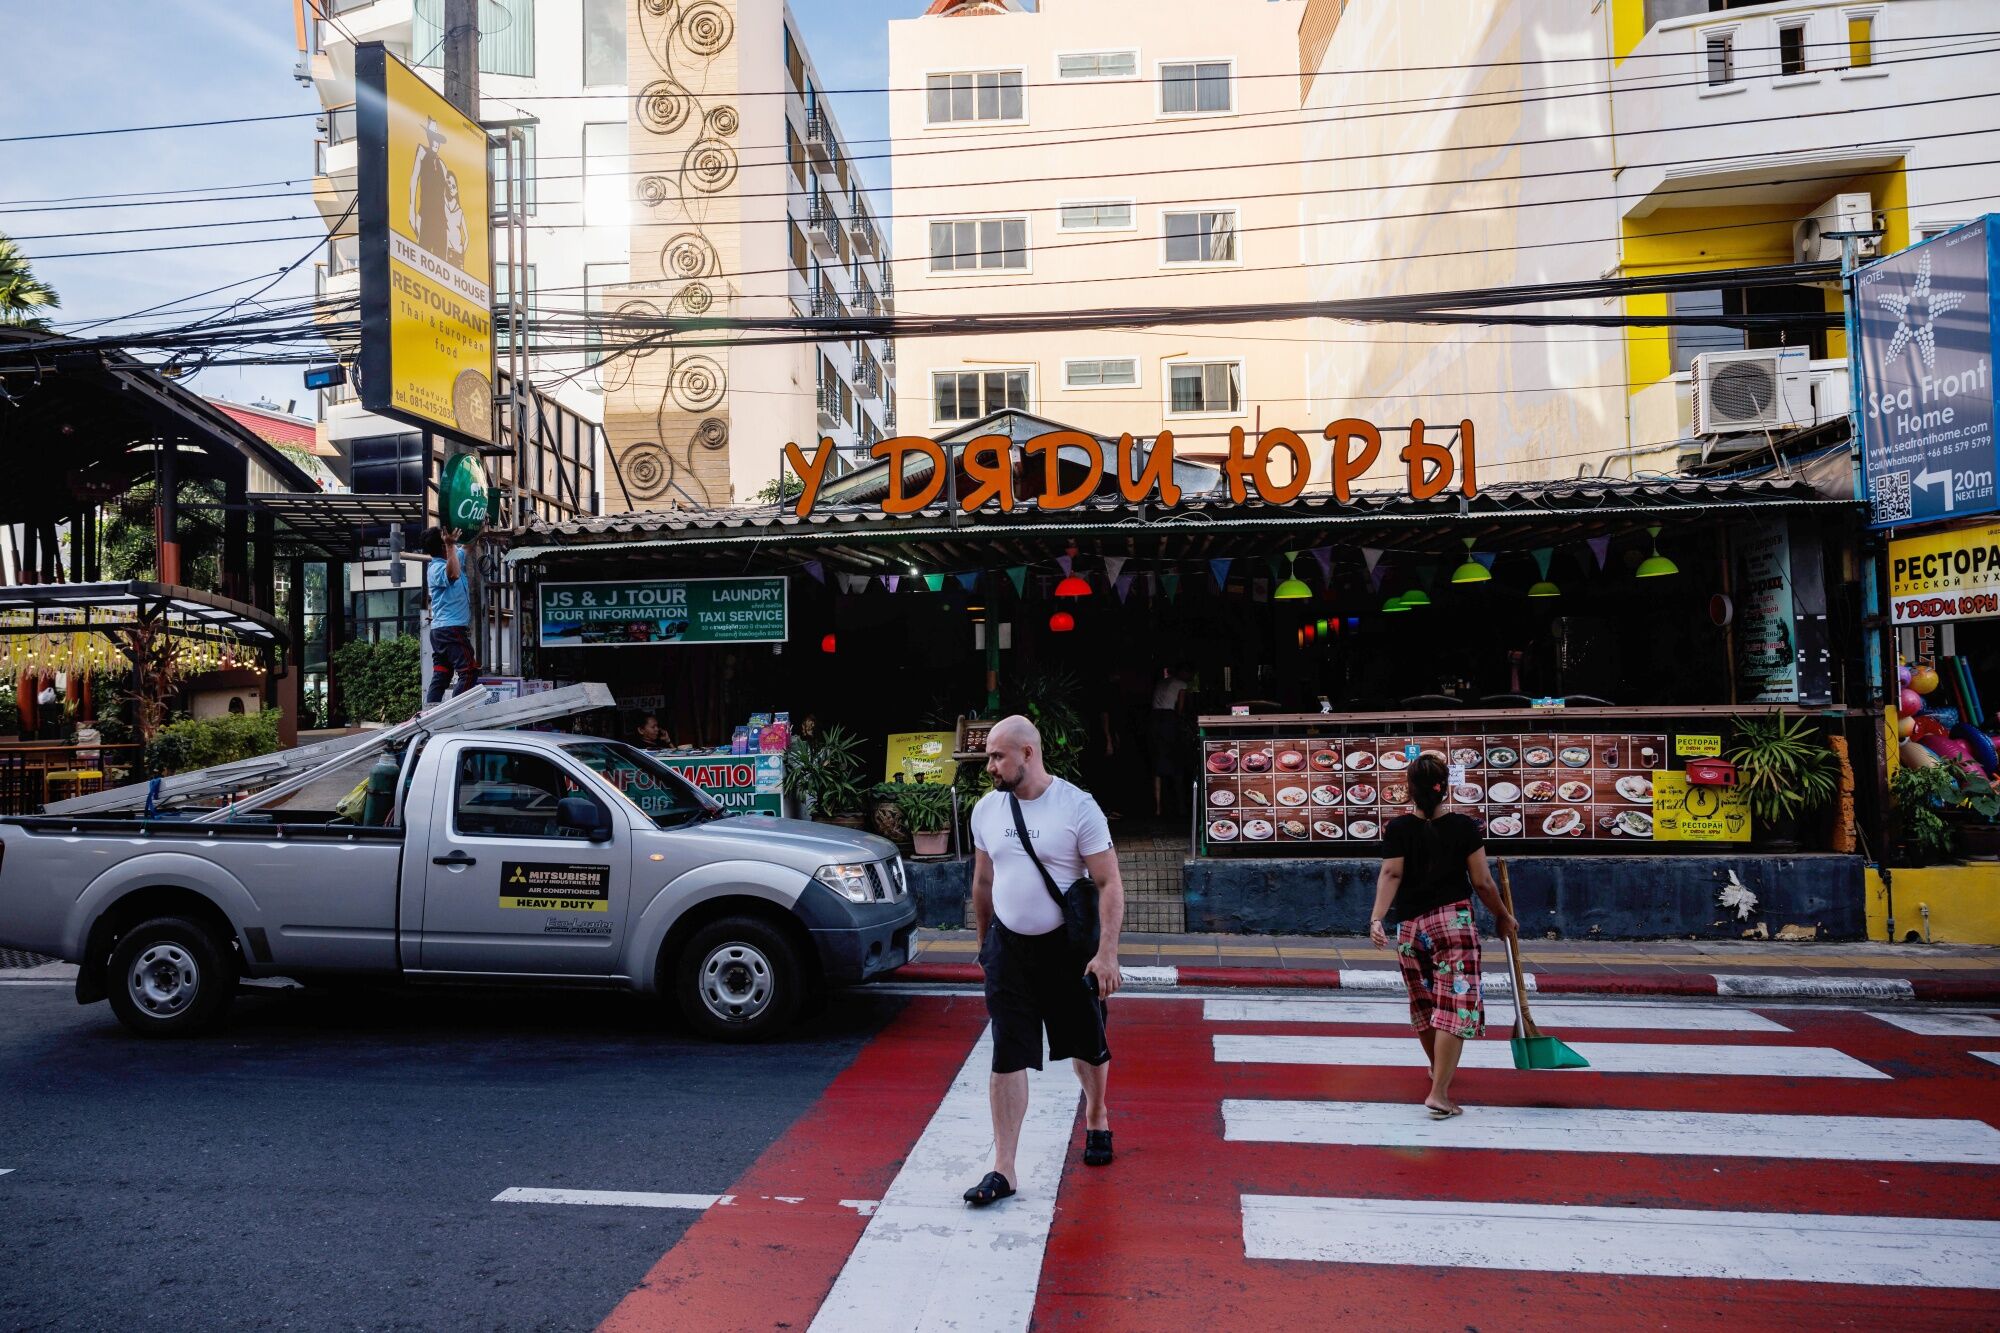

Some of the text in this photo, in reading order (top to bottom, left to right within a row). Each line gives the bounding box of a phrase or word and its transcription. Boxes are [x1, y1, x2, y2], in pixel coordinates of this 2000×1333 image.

[395, 239, 486, 302] THE ROAD HOUSE
[1859, 269, 1885, 288] HOTEL
[392, 270, 490, 336] RESTOURANT
[400, 300, 484, 352] Thai & European
[434, 337, 458, 359] food
[395, 389, 409, 404] tel.
[1868, 358, 1987, 419] Sea Front
[1897, 407, 1955, 435] Home
[1870, 422, 1988, 458] www.seafronthome.com
[1868, 435, 1992, 471] Call/Whatsapp: +66 85 579 5799
[784, 436, 836, 519] У
[1227, 418, 1478, 506] ЮРЫ
[1869, 477, 1876, 493] ME
[1954, 470, 1992, 492] 20m
[1955, 486, 1994, 502] NEXT LEFT
[457, 498, 486, 520] Cha
[1893, 544, 2000, 583] РЕСТОРА
[1894, 577, 1961, 592] РУССКОЙ
[546, 588, 687, 607] JS & J TOUR
[712, 588, 781, 602] LAUNDRY
[546, 607, 688, 621] TOUR INFORMATION
[698, 610, 783, 623] TAXI SERVICE
[1895, 601, 1905, 620] У
[1958, 593, 1998, 615] ЮРЫ
[1677, 738, 1719, 746] РЕСТОРАН
[1682, 821, 1723, 829] РЕСТОРАН
[529, 871, 601, 881] MITSUBISHI
[516, 899, 595, 909] HEAVY DUTY
